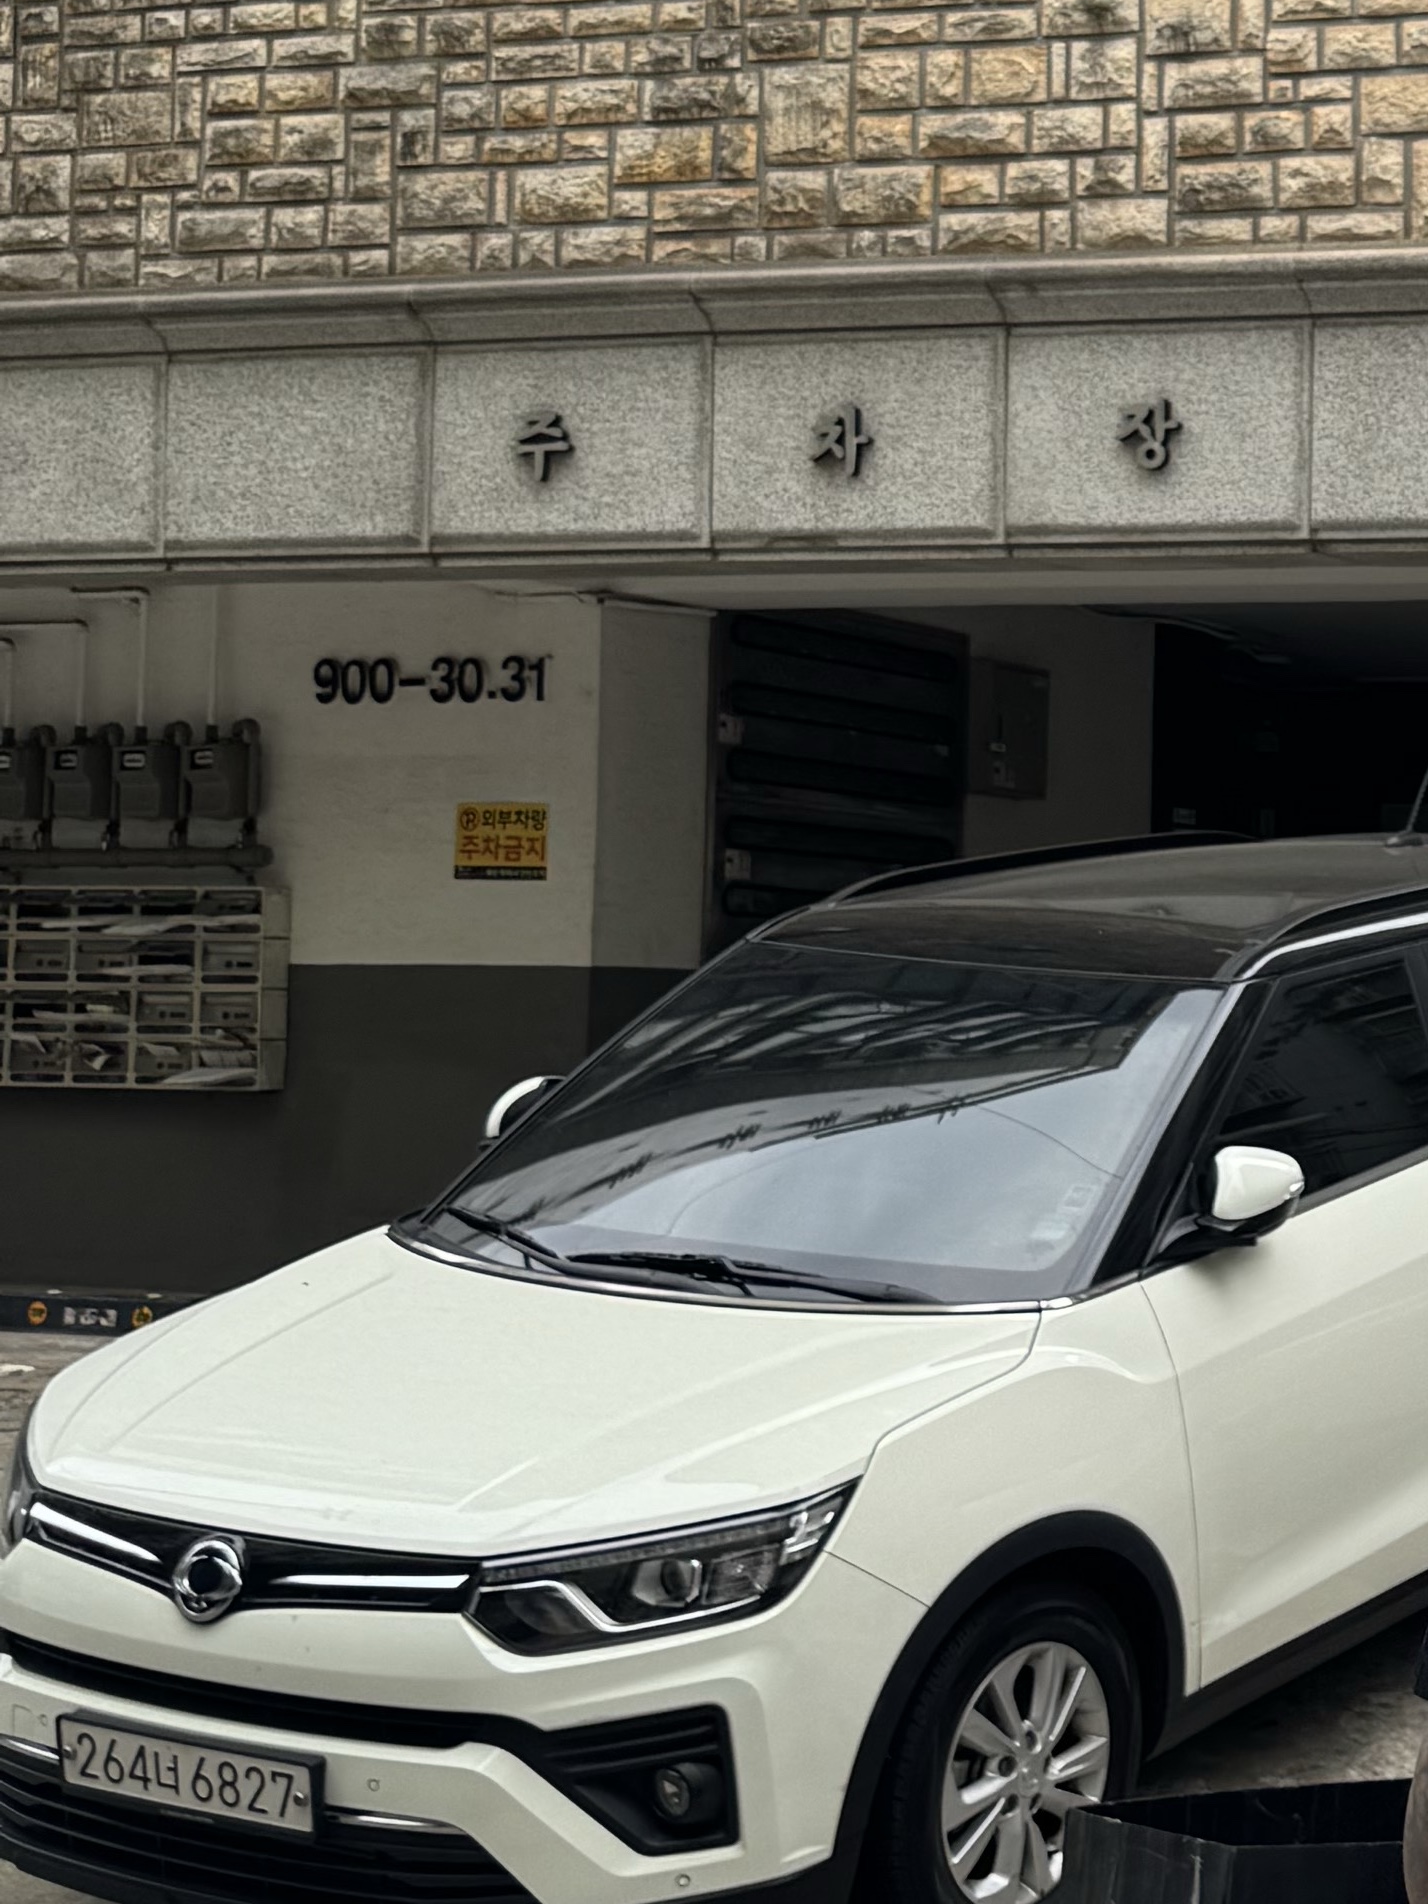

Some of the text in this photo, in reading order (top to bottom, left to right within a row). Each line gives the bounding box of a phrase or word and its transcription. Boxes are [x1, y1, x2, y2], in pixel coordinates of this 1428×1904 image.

[518, 399, 1181, 481] 주차장
[313, 655, 547, 704] 900-30.31
[482, 808, 546, 831] 외부차량
[459, 835, 545, 862] 주차금지
[77, 1732, 295, 1818] 264너 6827
